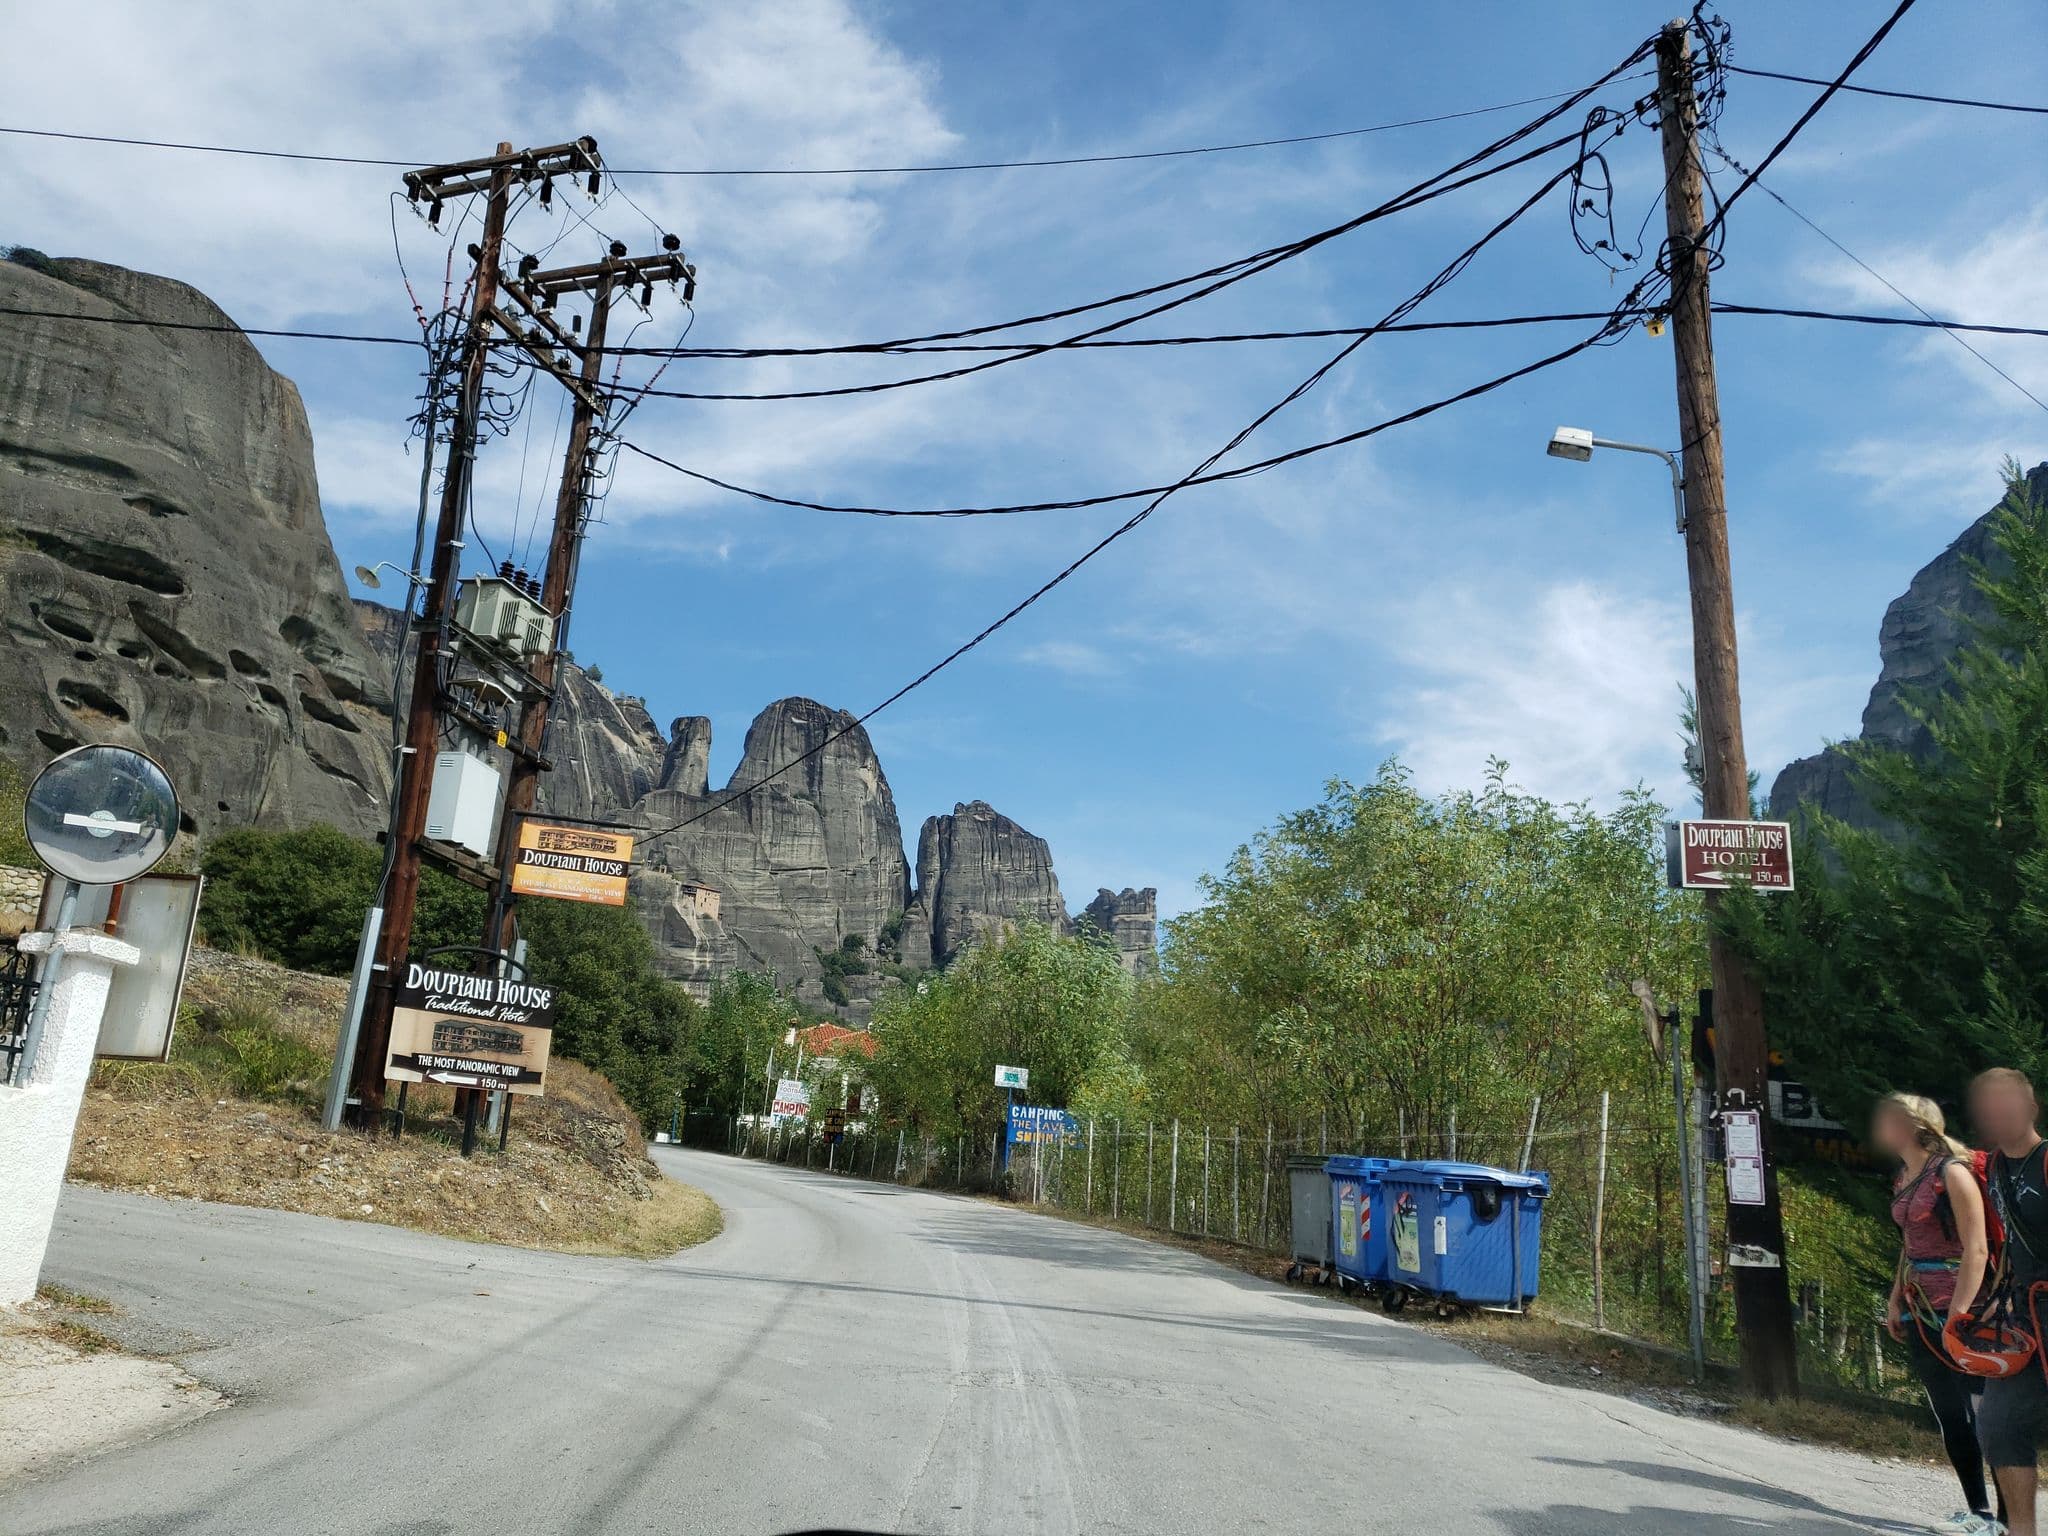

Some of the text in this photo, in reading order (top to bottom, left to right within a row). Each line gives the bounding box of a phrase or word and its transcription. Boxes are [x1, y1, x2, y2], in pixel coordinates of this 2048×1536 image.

[523, 849, 581, 871] DOUPIANI
[584, 857, 623, 876] HOUSE
[1702, 851, 1773, 867] HOTEL
[1756, 871, 1771, 882] 150
[406, 963, 551, 1010] DOUPIANI HOUSE
[424, 994, 533, 1023] Traditional Hotel
[418, 1055, 520, 1077] THE MOST PANORAMIC VIEW
[480, 1078, 496, 1089] 150
[1012, 1119, 1031, 1129] THE
